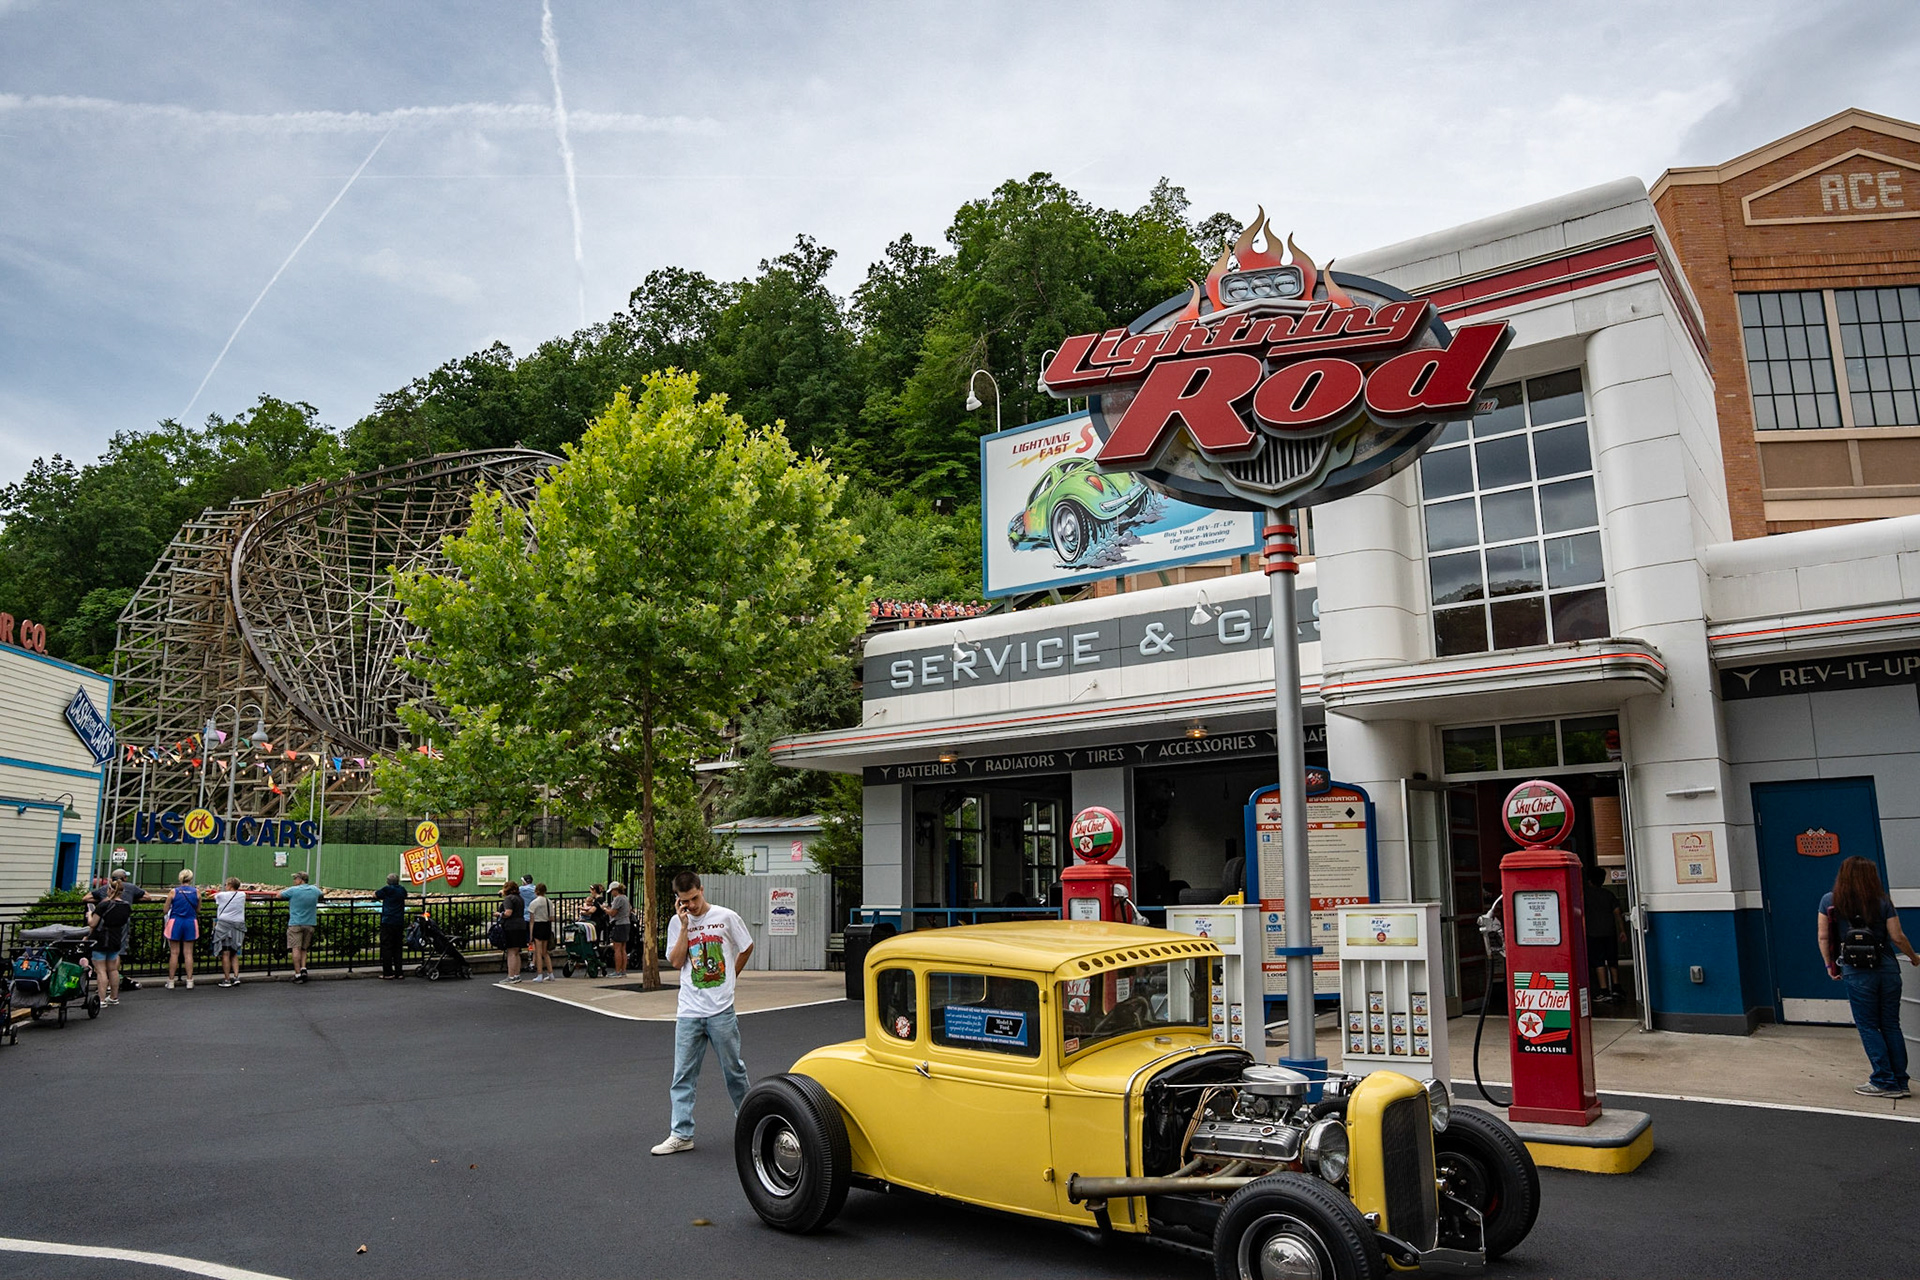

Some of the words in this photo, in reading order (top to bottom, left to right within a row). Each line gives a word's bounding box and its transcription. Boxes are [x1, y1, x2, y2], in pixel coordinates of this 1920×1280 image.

[1820, 171, 1905, 211] ACE
[1043, 299, 1431, 386] Lightning
[1095, 320, 1509, 462] Rod
[1012, 431, 1071, 454] LIGHTNING
[1039, 443, 1069, 459] FAST
[1163, 529, 1178, 538] Buy
[1180, 527, 1195, 536] Your
[1182, 529, 1230, 542] Race-Winning
[1174, 541, 1197, 551] Engine
[1198, 537, 1226, 547] Booster
[890, 631, 1100, 689] SERVICE
[1140, 622, 1175, 656] &
[70, 692, 92, 730] CASH
[91, 722, 113, 758] CARS
[897, 762, 957, 778] BATTERIES
[985, 754, 1055, 771] RADIATORS
[1086, 747, 1125, 763] TIRES
[1158, 735, 1257, 757] ACCESSORIES
[1303, 728, 1326, 742] AP
[1514, 799, 1530, 814] Sky
[1531, 797, 1557, 812] Chief
[133, 811, 225, 844] USD
[235, 815, 318, 849] CARS
[188, 813, 210, 833] OK
[1075, 821, 1087, 836] Sky
[1087, 818, 1106, 833] Chief
[418, 825, 435, 843] OK
[408, 847, 436, 860] DRIVE
[411, 856, 438, 873] BUY
[414, 864, 443, 880] ONE
[1515, 990, 1535, 1011] Sky
[1538, 990, 1570, 1008] Chief
[1524, 1045, 1567, 1053] GASOLINE
